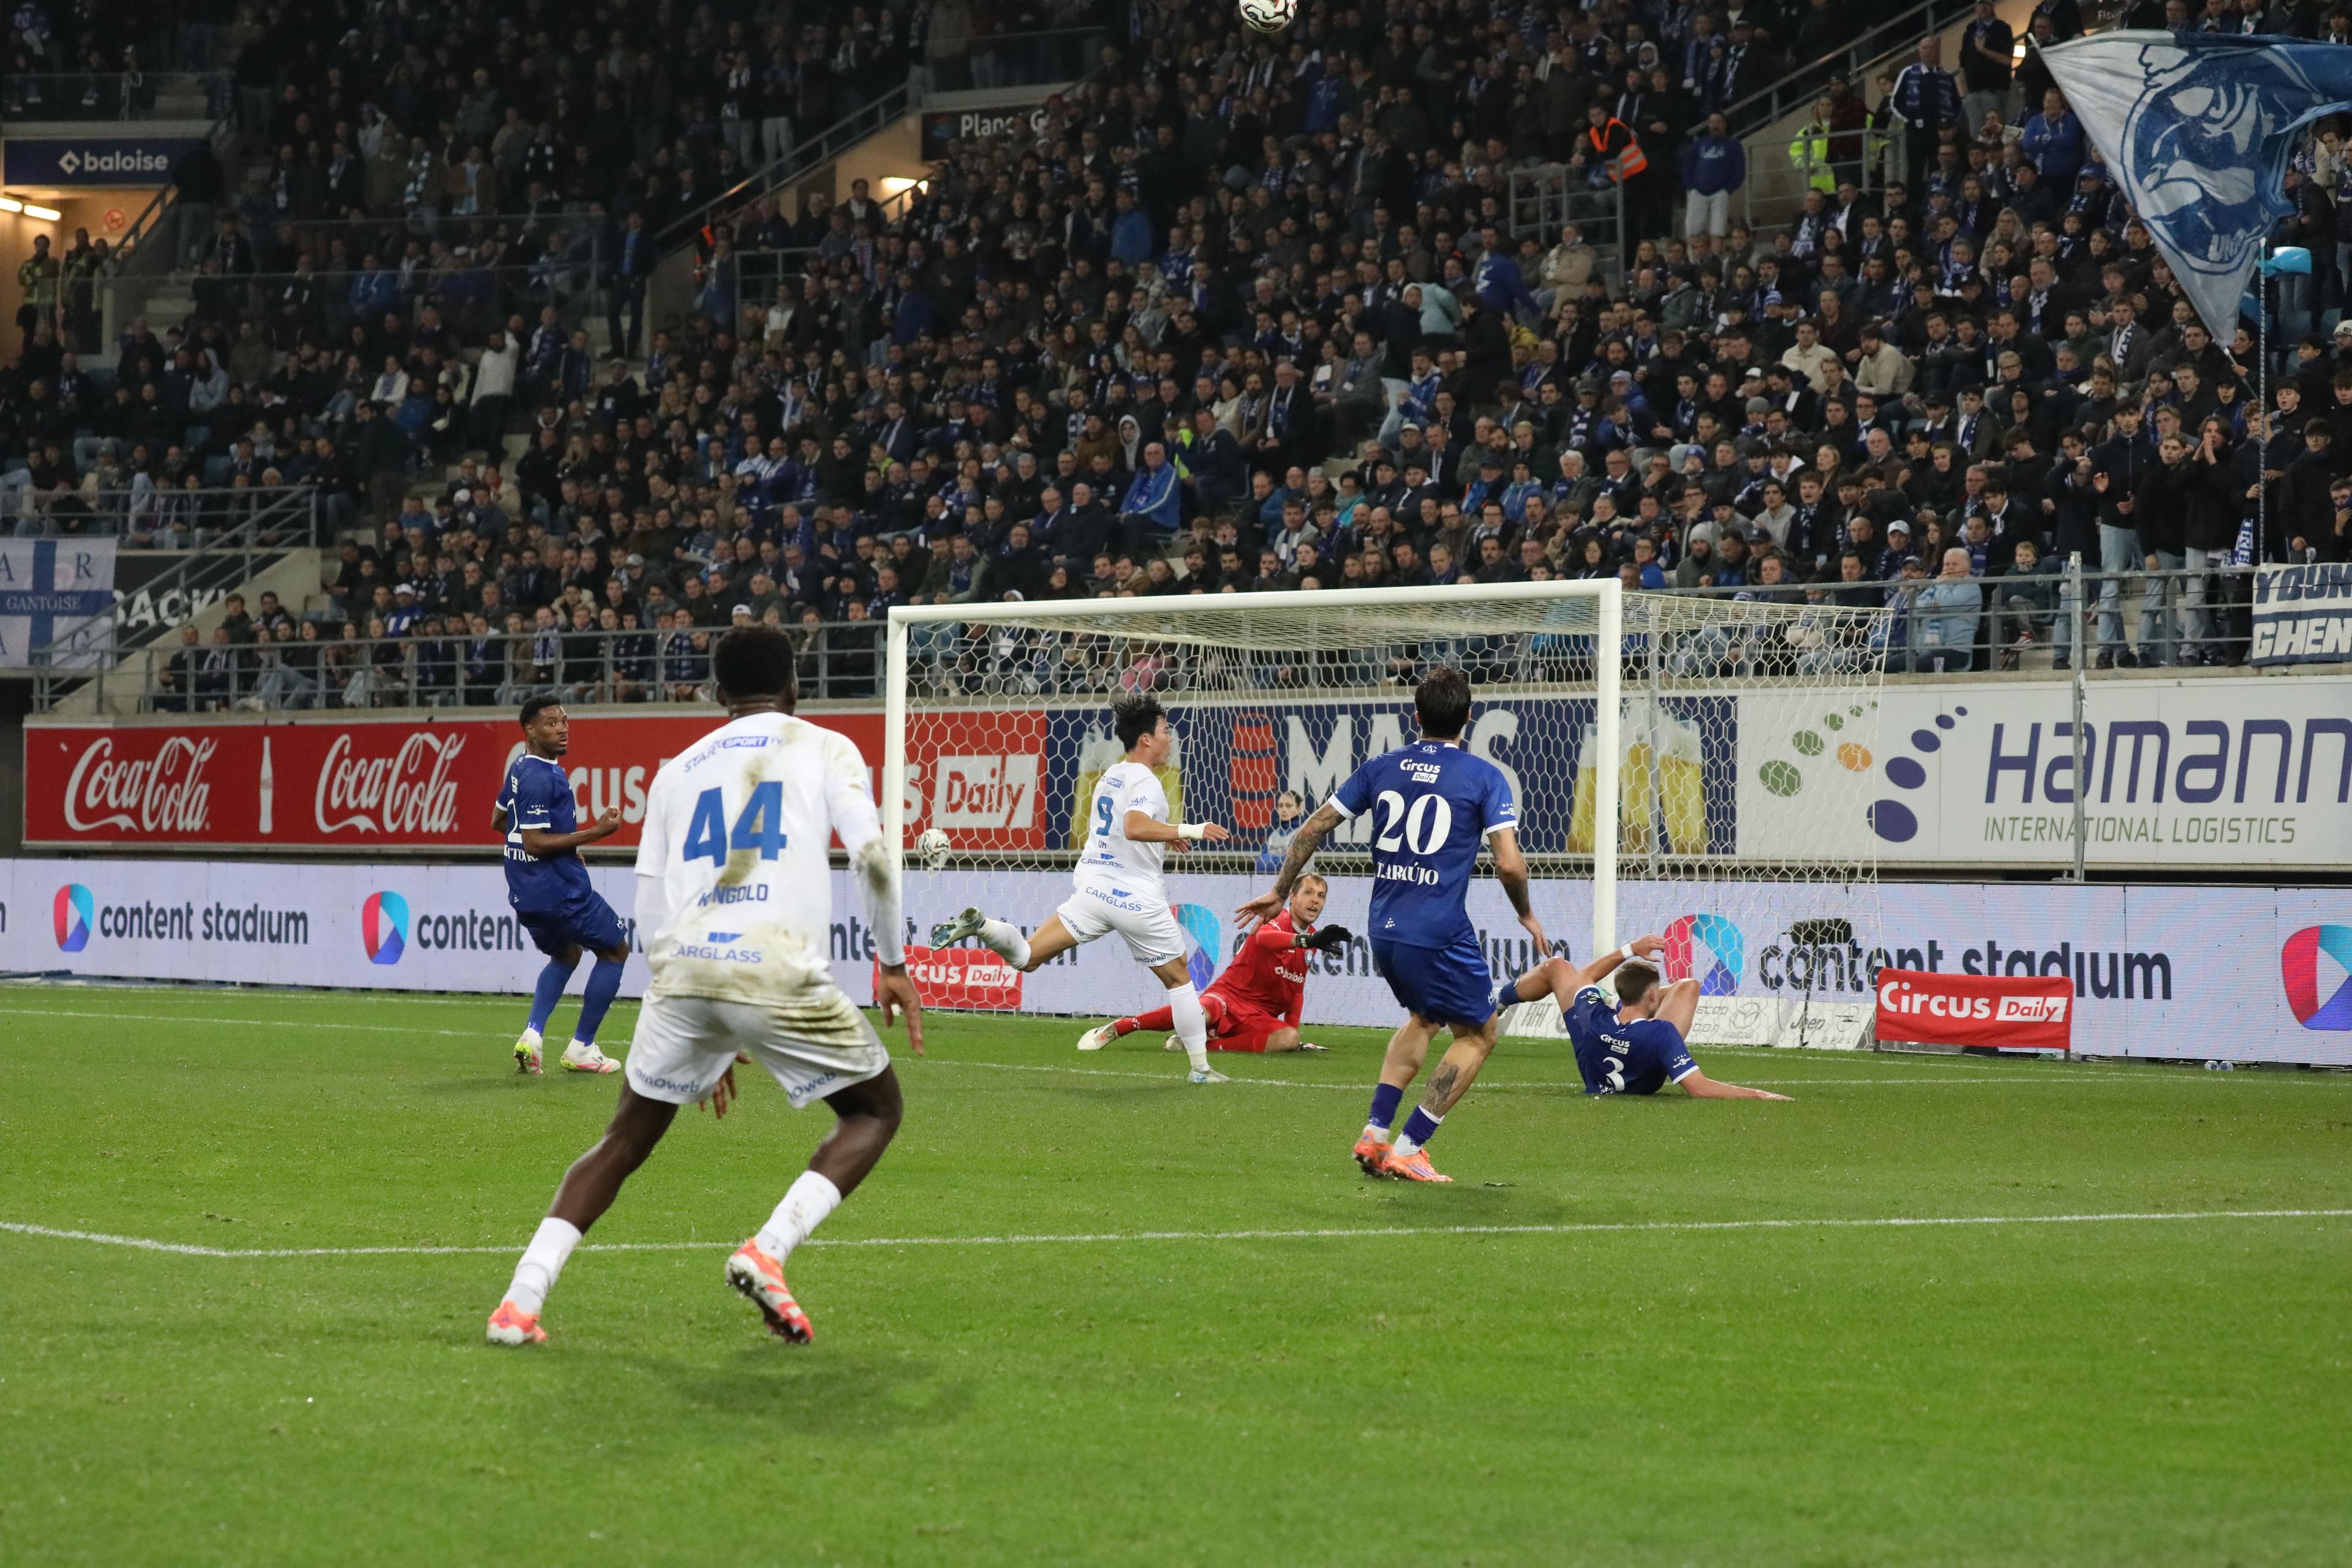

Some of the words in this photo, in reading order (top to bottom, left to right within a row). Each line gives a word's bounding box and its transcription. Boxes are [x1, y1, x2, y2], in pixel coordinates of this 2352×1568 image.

[84, 149, 168, 172] baloise
[7, 596, 81, 611] GANTOISE
[725, 737, 766, 747] SPORT
[1287, 709, 1522, 843] MAS
[1400, 758, 1441, 774] Circus
[1415, 773, 1434, 783] Daily
[945, 773, 1025, 820] Daily
[683, 781, 787, 868] 44
[1096, 796, 1114, 836] 9
[1376, 790, 1452, 855] 20
[1984, 816, 2162, 843] INTERNATIONAL
[2173, 817, 2296, 843] LOGISTICS
[698, 884, 769, 907] KNGOLO
[1085, 887, 1142, 911] CARGLASS
[100, 900, 193, 941] content
[202, 901, 308, 945] stadium
[971, 968, 1012, 986] Daily
[1283, 970, 1305, 983] balois
[1759, 938, 1943, 992] content
[1880, 981, 1991, 1019] Circus
[2005, 1000, 2059, 1021] Daily
[1600, 1034, 1630, 1047] Circus
[1602, 1057, 1625, 1091] 3
